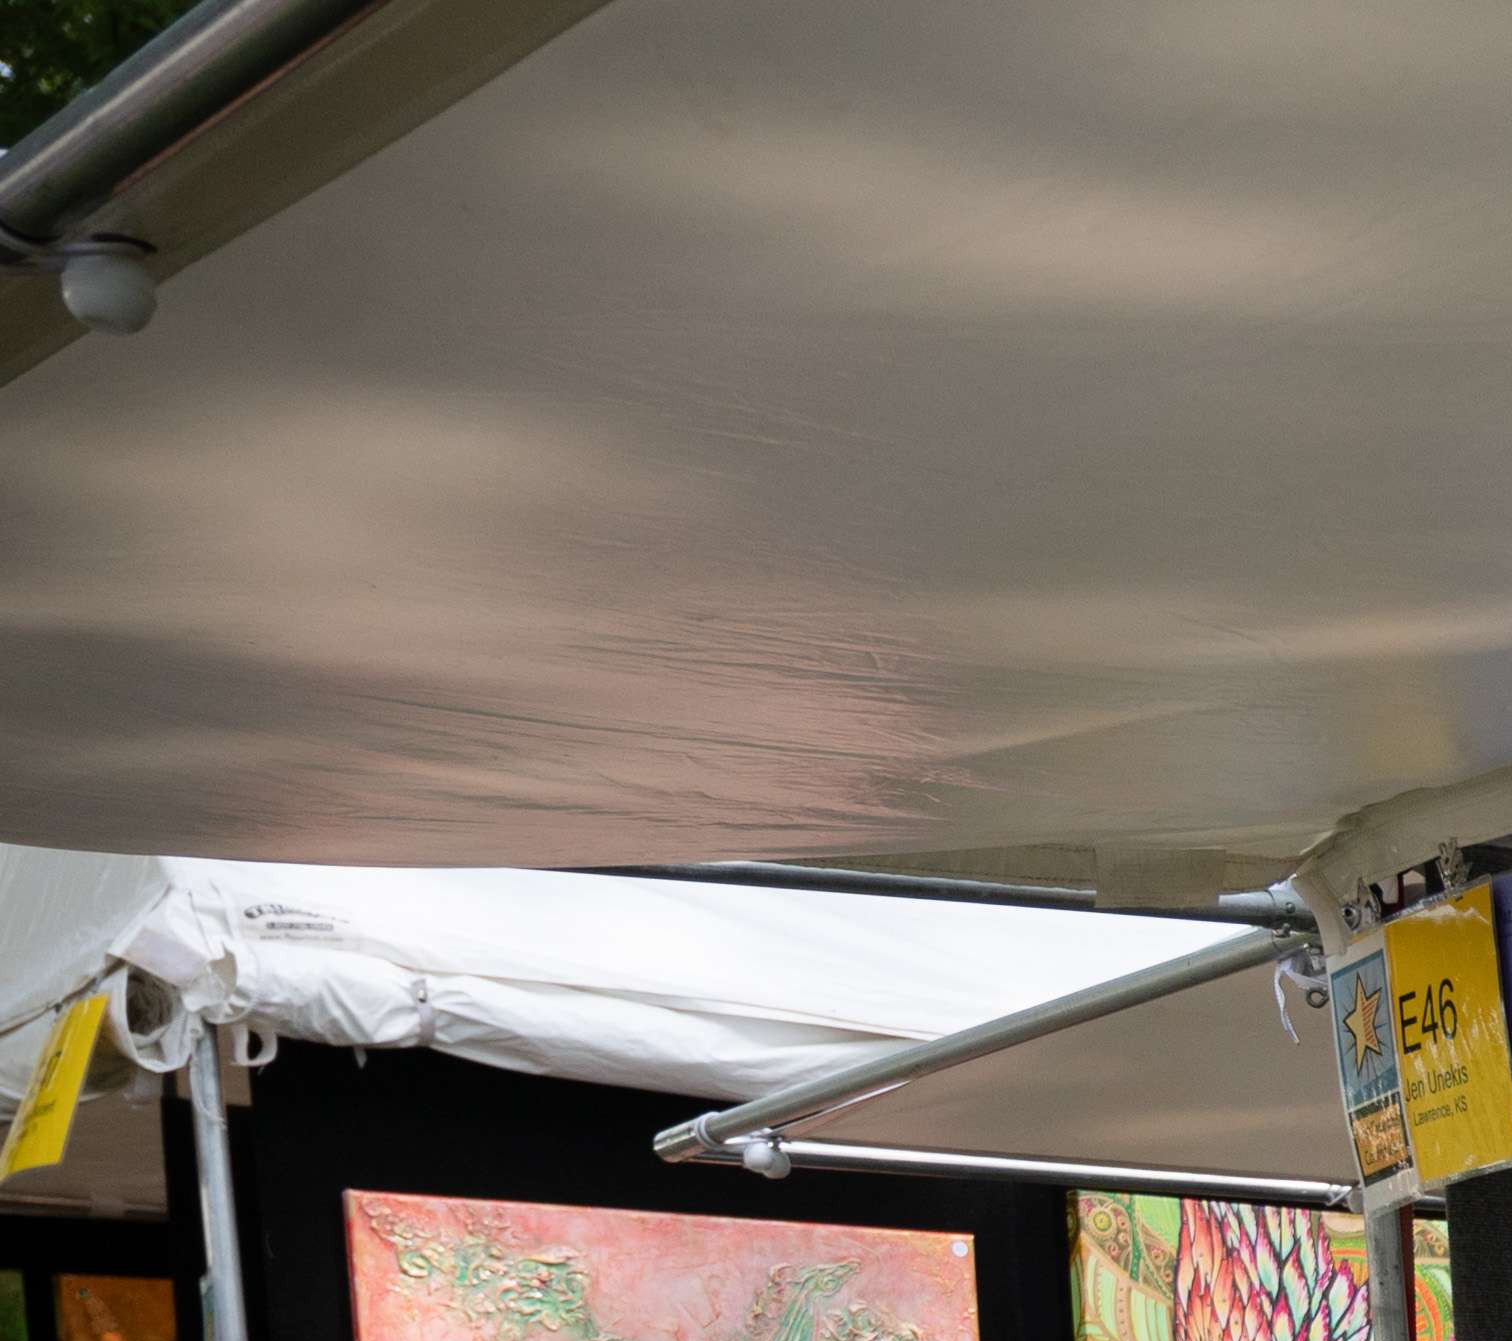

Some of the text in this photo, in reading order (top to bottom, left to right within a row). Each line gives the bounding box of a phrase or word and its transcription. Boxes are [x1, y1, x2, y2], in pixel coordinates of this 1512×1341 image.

[1398, 977, 1458, 1055] E46
[1405, 1063, 1470, 1103] Jen Unekis
[1413, 1094, 1469, 1126] Lawrence, KS
